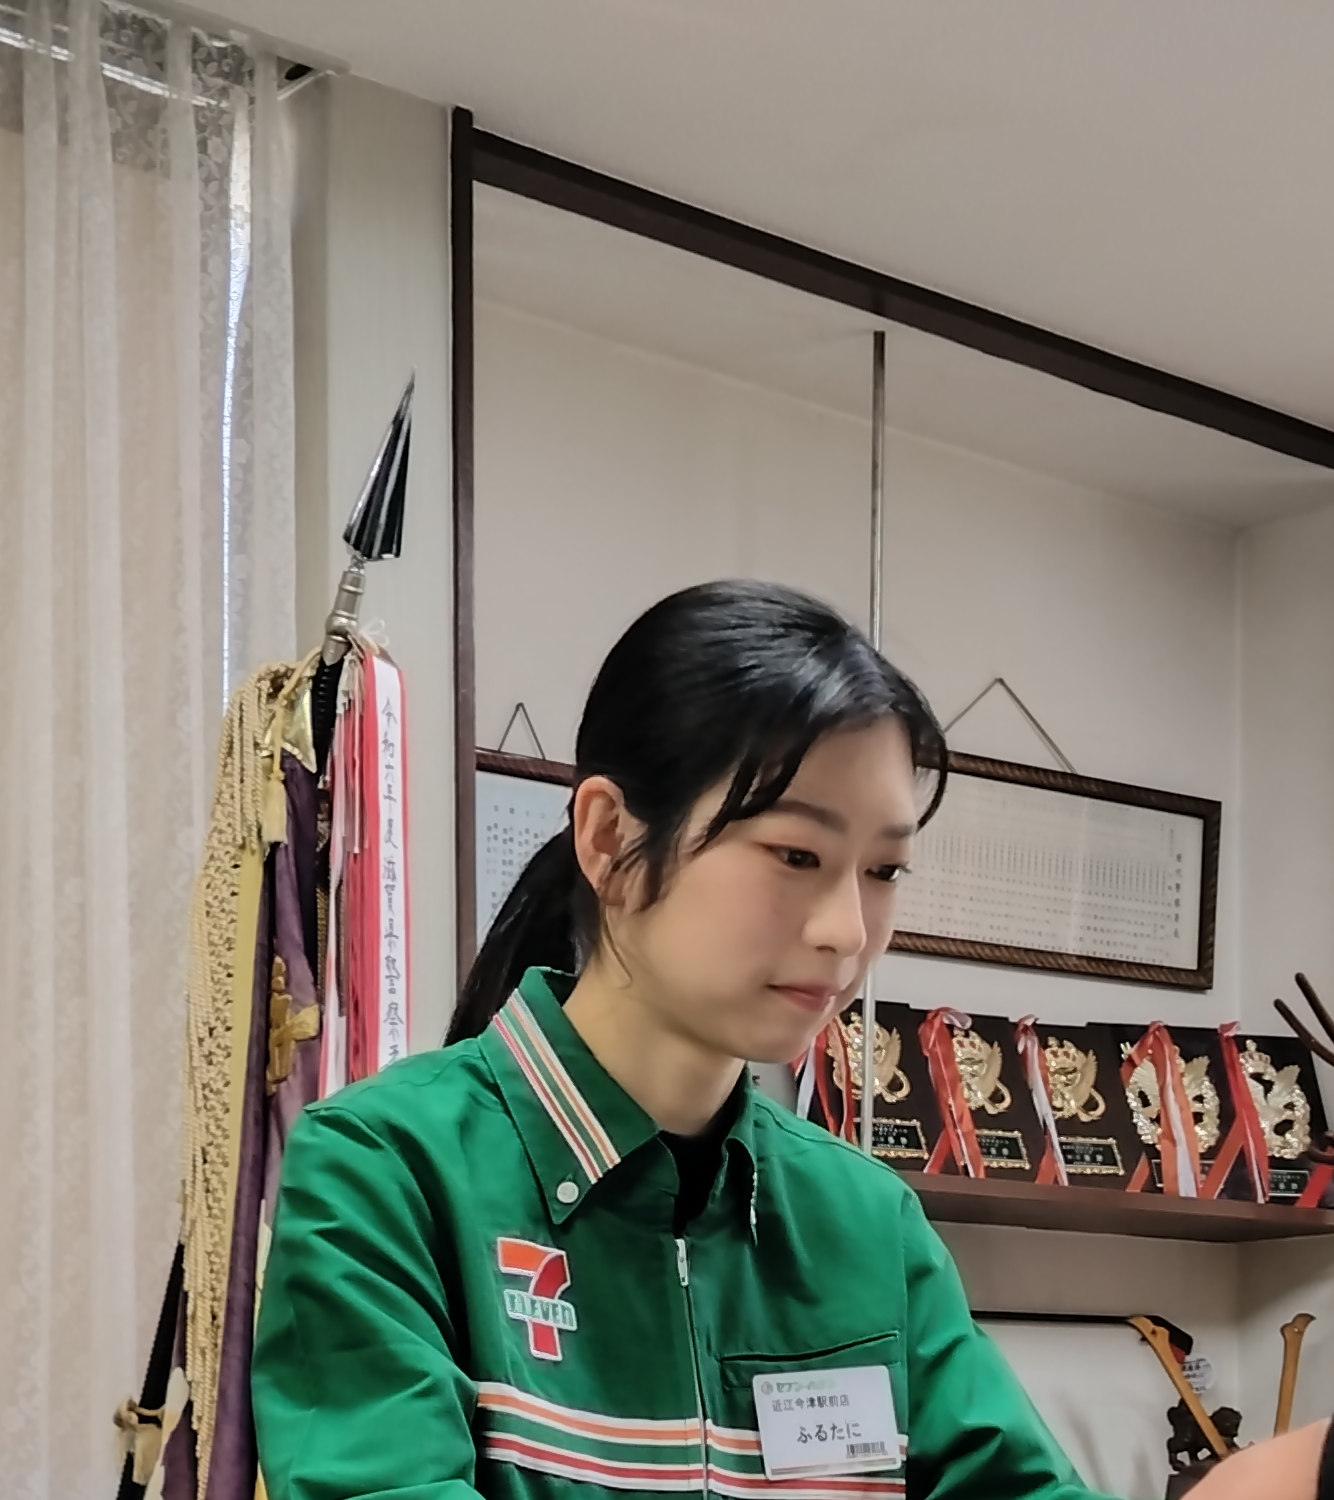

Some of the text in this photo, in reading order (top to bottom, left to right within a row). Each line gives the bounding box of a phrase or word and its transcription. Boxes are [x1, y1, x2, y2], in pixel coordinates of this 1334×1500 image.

[771, 1394, 851, 1412] 近江今津駅前店
[796, 1420, 863, 1444] ふるたに
